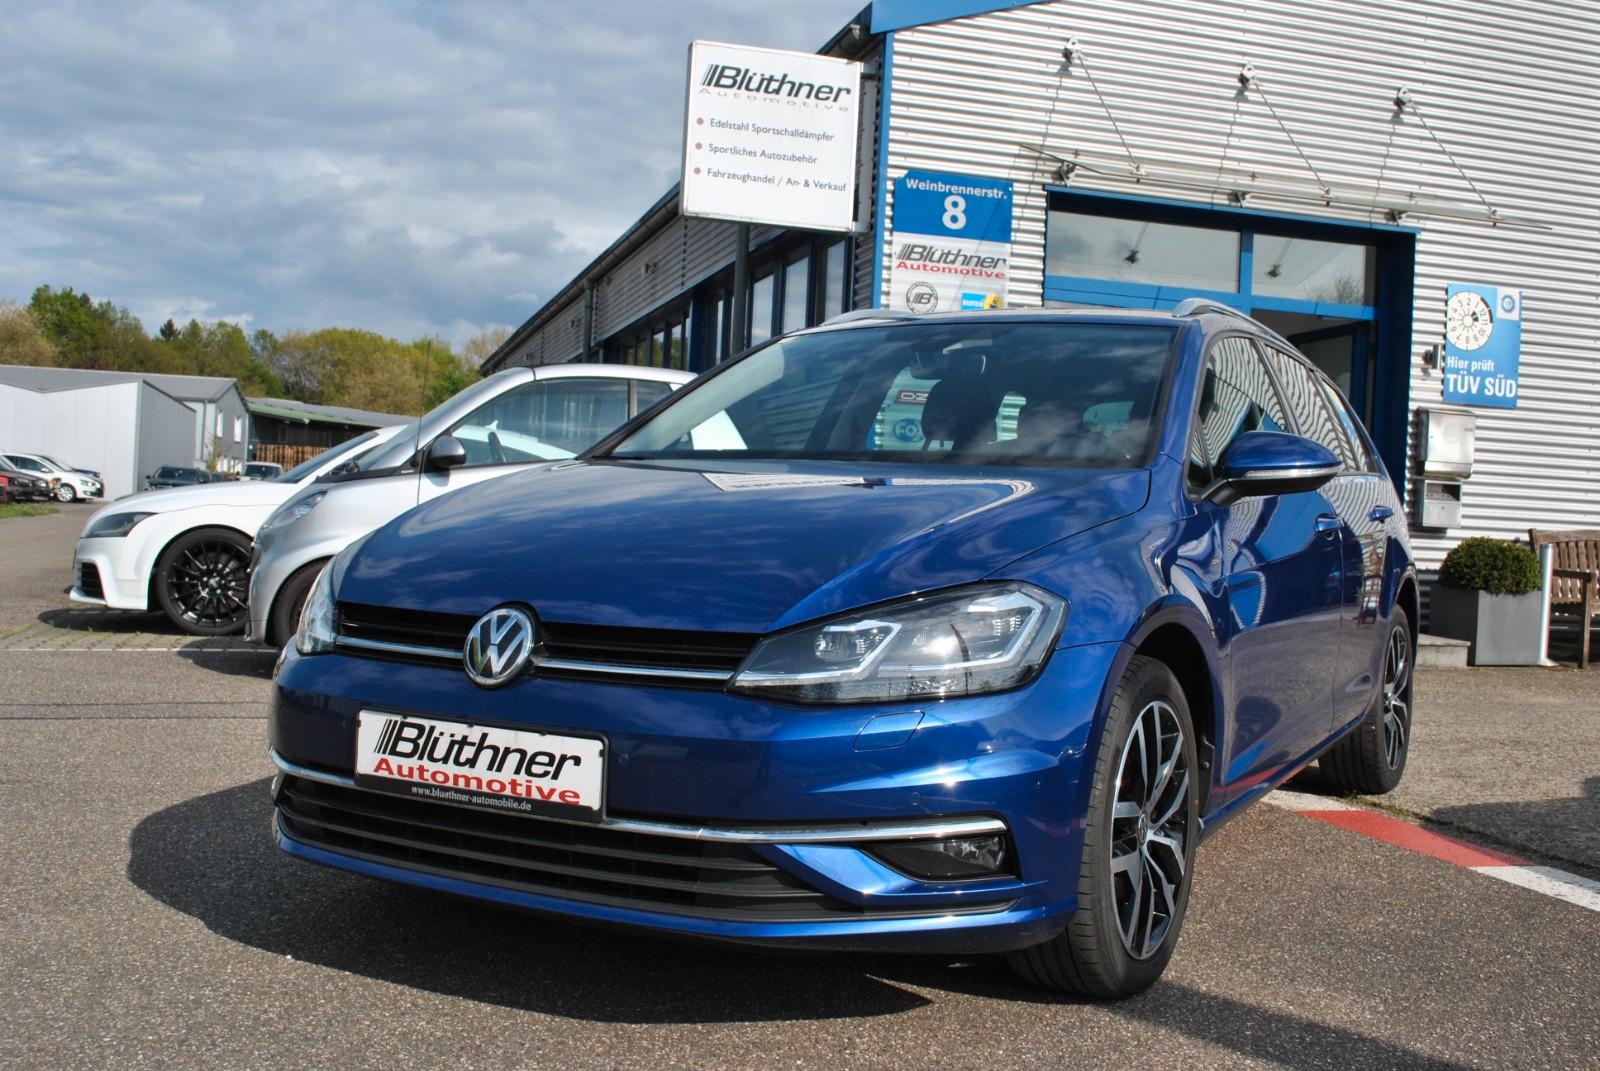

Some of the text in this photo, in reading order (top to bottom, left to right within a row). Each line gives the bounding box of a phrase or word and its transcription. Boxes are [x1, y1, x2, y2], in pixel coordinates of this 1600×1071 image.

[712, 64, 852, 102] Blüthner
[698, 88, 849, 112] Automotive
[710, 118, 835, 142] Edelstahl Sportschalldämpfer
[708, 143, 818, 164] Sportliches Autozubehör
[707, 168, 775, 184] Fahrzeughandel
[786, 177, 801, 187] An-
[803, 178, 810, 188] &
[813, 179, 847, 192] Verkauf
[906, 178, 1008, 199] Weinbrennerstr.
[942, 195, 967, 230] 8
[906, 244, 1007, 270] Blüthner
[896, 261, 1006, 279] Automotive
[1447, 356, 1495, 372] Hier prüft
[1446, 371, 1517, 398] TÜV SÜD
[386, 719, 582, 781] Blüthner
[373, 757, 581, 806] Automotive
[411, 785, 532, 811] www.bluethner-automobile.de
